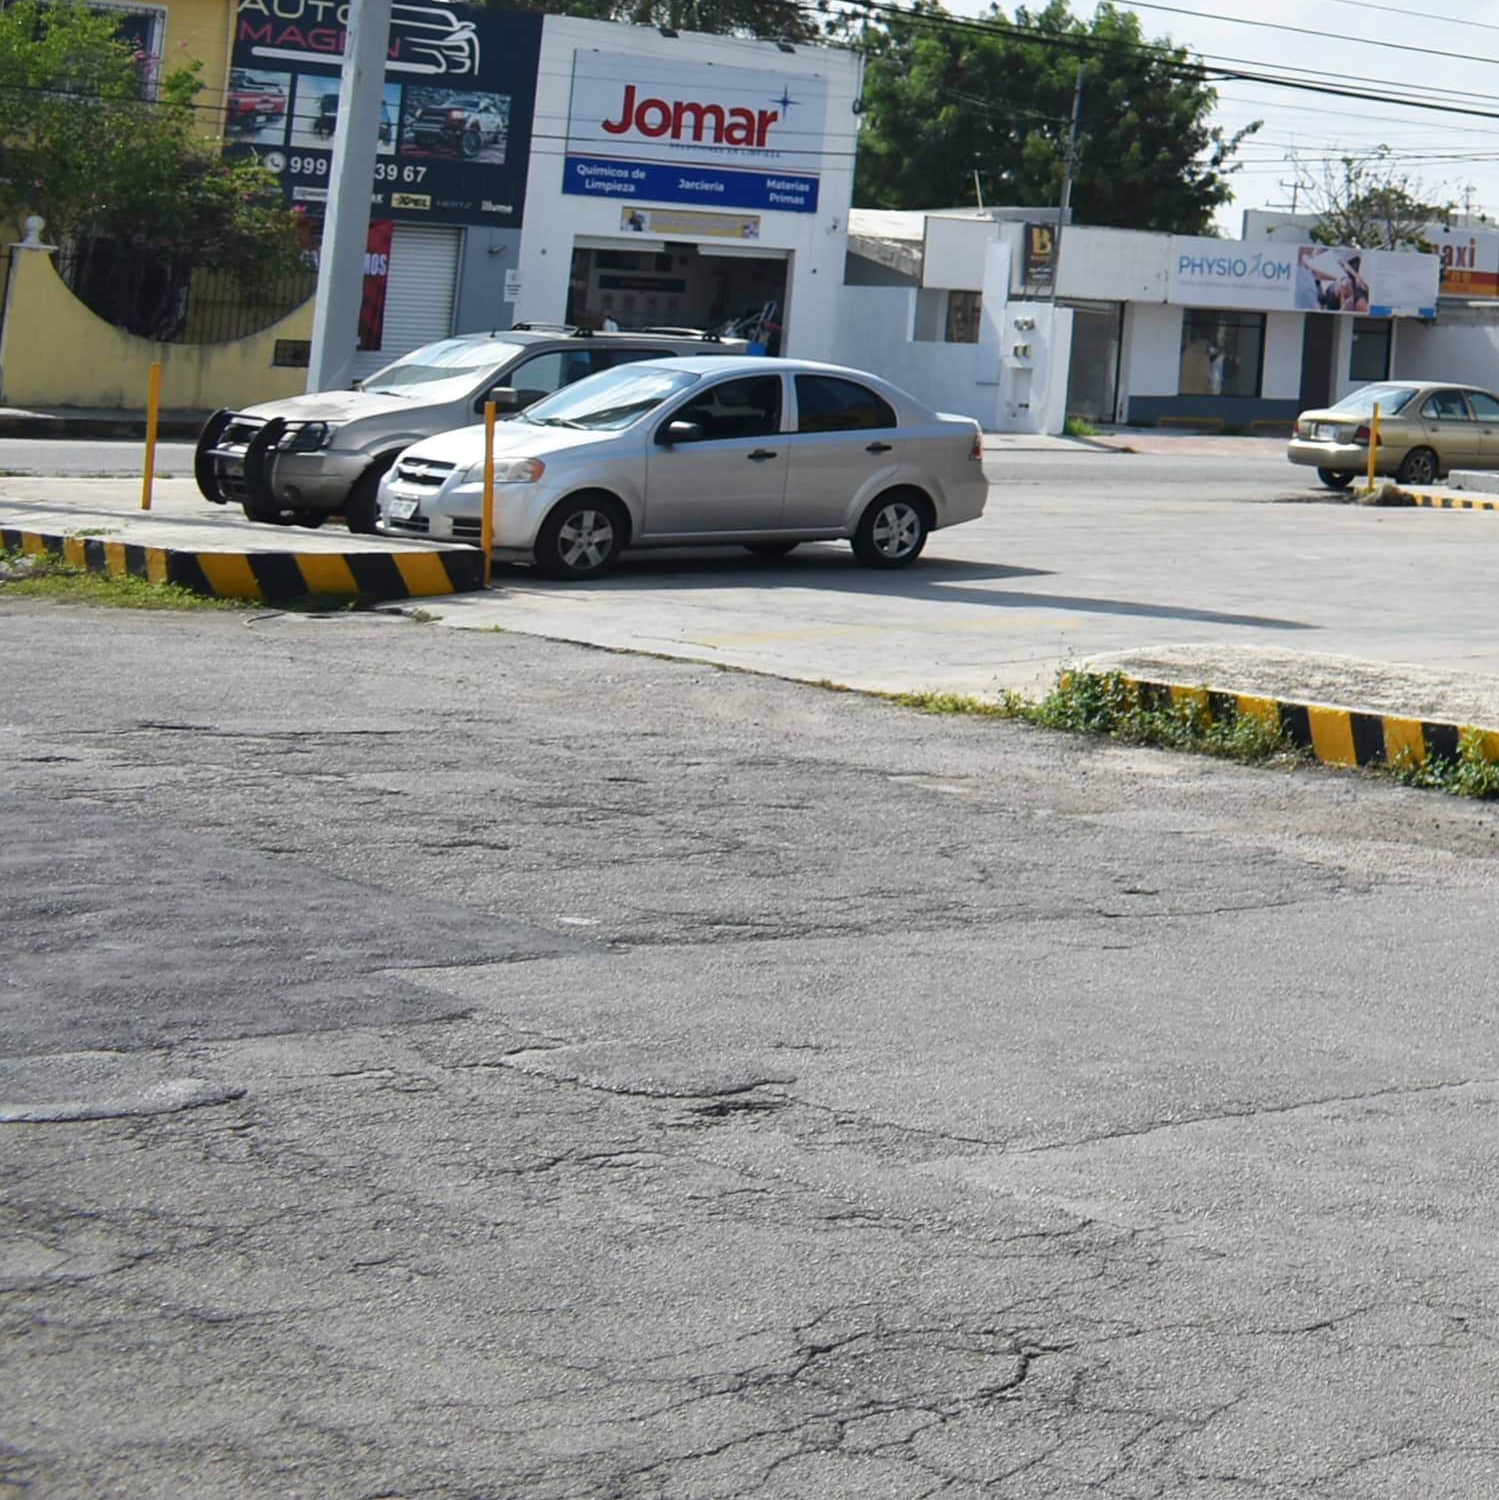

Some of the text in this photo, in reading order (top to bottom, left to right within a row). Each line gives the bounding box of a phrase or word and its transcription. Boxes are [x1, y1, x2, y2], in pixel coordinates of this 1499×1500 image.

[602, 84, 779, 148] Jomar
[290, 155, 328, 176] 999
[403, 166, 427, 183] 67
[576, 163, 646, 180] Químicos de
[585, 177, 635, 193] Limpieza
[766, 178, 810, 193] Materias
[768, 192, 805, 206] Primas
[1430, 237, 1476, 269] axi
